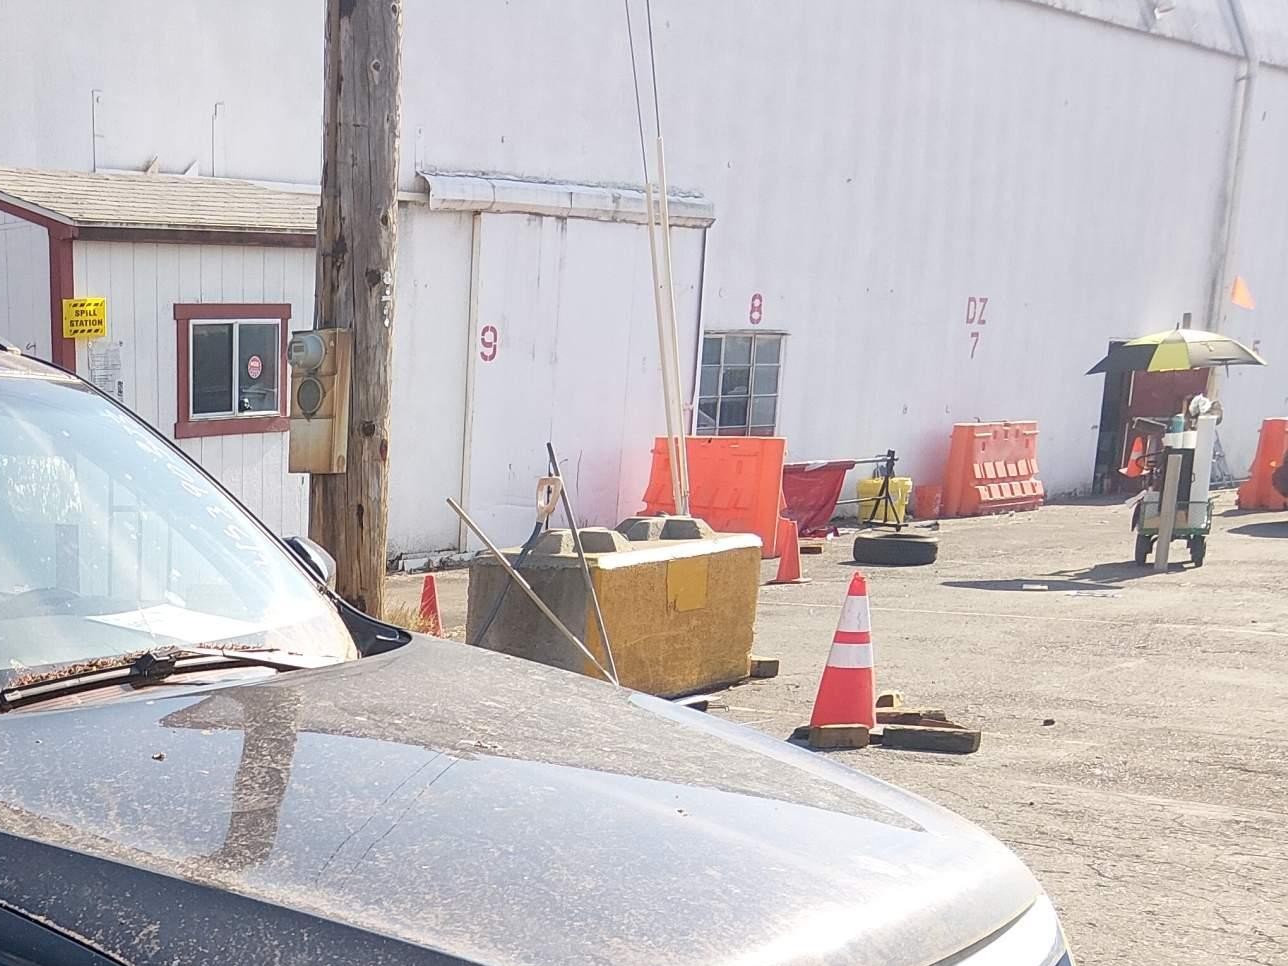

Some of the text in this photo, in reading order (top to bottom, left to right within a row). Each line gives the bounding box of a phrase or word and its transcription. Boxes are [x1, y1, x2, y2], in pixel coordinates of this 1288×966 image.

[69, 319, 103, 327] STATION
[74, 309, 98, 317] SPILL
[749, 293, 762, 325] 8
[966, 296, 988, 325] DZ
[480, 325, 497, 361] 9
[970, 331, 979, 360] 7
